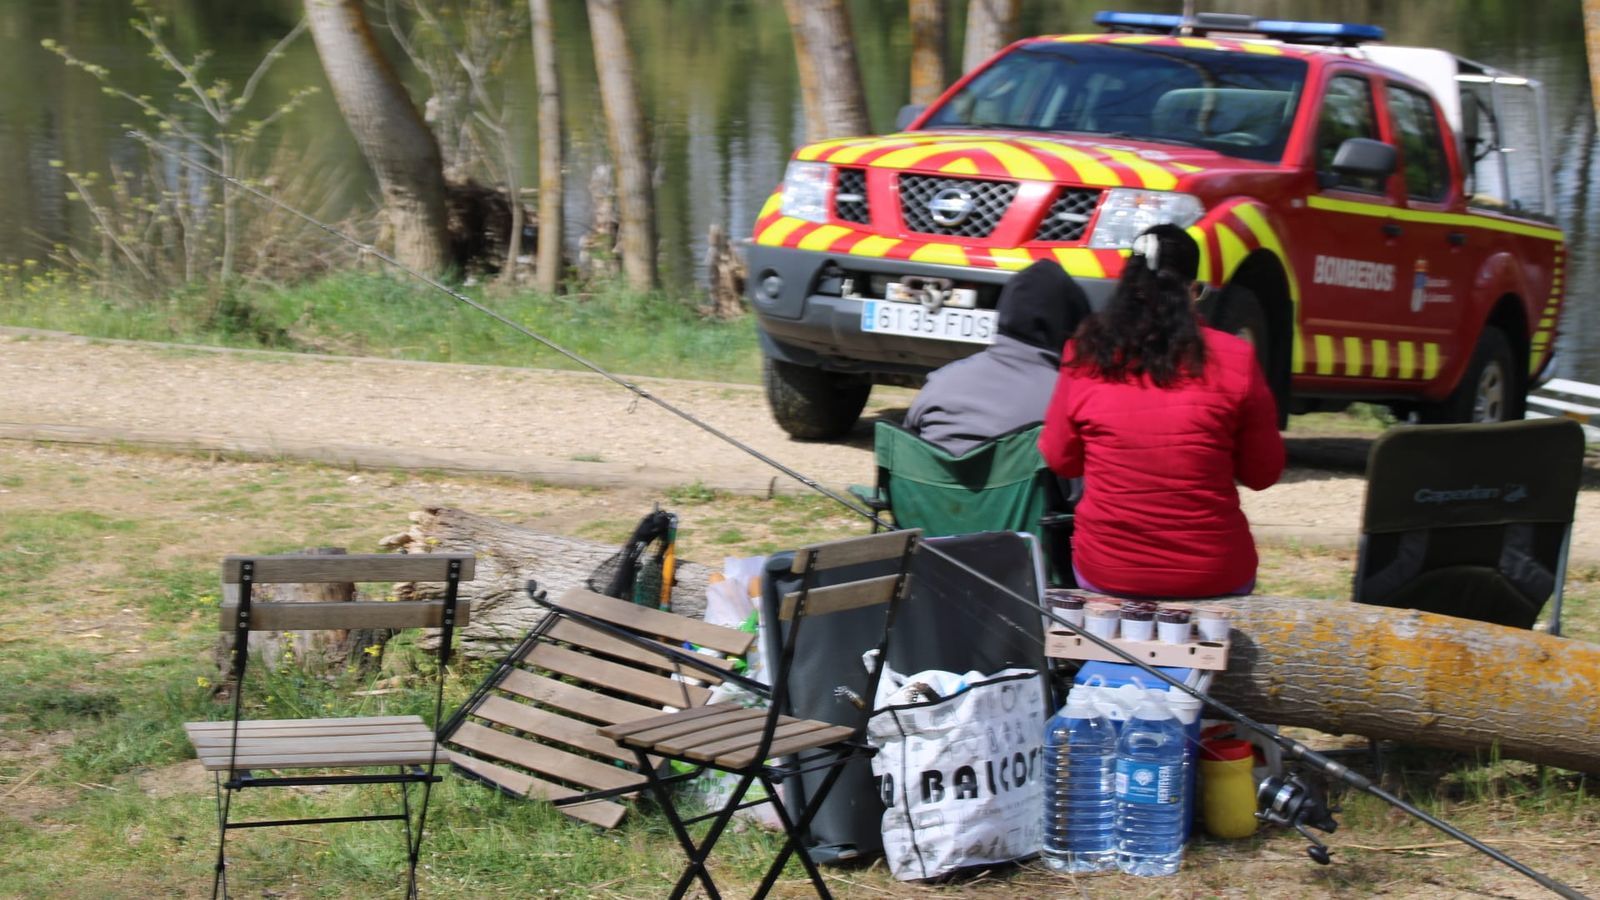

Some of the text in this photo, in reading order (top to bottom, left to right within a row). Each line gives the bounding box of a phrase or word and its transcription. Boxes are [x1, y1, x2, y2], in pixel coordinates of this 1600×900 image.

[1313, 254, 1396, 292] BOMBEROS
[878, 306, 992, 338] 6135 FDS
[1414, 485, 1501, 504] Caperlan
